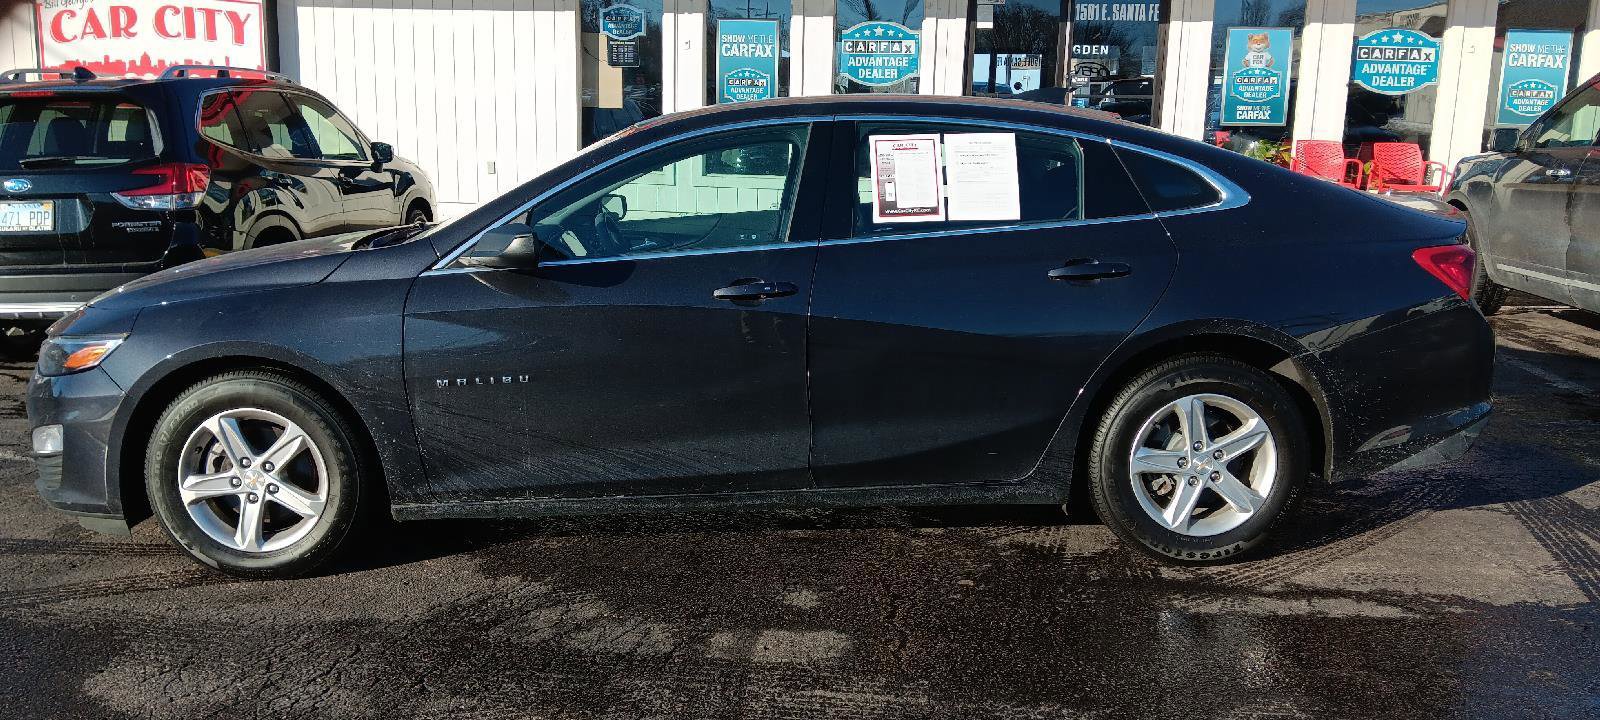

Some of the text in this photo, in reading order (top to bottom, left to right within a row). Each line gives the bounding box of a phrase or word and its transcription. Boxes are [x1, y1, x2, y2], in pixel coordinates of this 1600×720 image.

[1075, 3, 1160, 22] 1501 E. SANTA FE
[50, 4, 252, 46] CAR CITY
[721, 34, 773, 43] SHOW ME THE
[721, 44, 773, 58] CARFAX
[844, 40, 913, 54] CARFAX
[1510, 44, 1536, 53] SHOW
[1537, 44, 1549, 54] ME
[1359, 47, 1433, 62] CARFAX
[1508, 53, 1566, 68] CARFAX
[847, 57, 909, 67] ADVANTAGE
[858, 68, 898, 79] DEALER
[1361, 63, 1427, 76] ADVANTAGE
[728, 78, 767, 87] CARFAX
[1236, 76, 1278, 84] CARFAX
[1371, 76, 1415, 87] DEALER
[1511, 90, 1553, 98] CARFAX
[1512, 98, 1549, 106] ADVANTAGE
[1236, 110, 1271, 120] CARFAX
[2, 211, 51, 226] 471 PDP
[436, 375, 529, 388] MALIBU
[1142, 533, 1244, 560] Firesto
